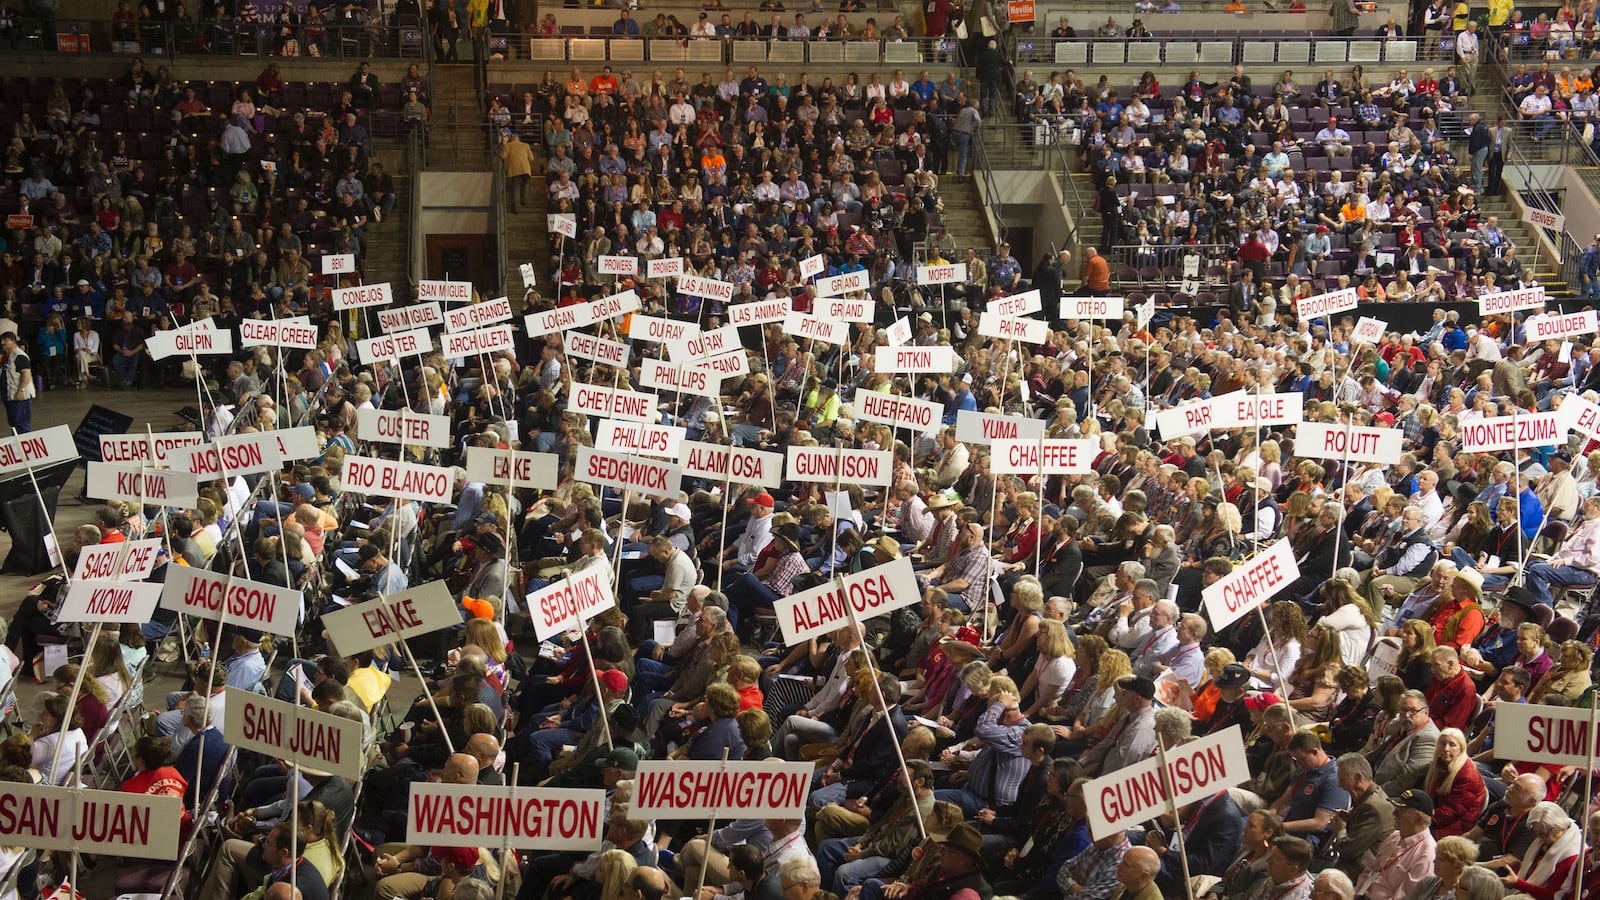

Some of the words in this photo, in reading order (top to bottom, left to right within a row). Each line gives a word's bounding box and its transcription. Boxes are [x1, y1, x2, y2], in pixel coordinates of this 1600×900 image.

[1010, 5, 1033, 15] Neville
[1531, 211, 1555, 226] DENVER
[331, 257, 345, 270] BENT
[604, 258, 633, 272] PROWERS
[653, 261, 679, 274] PROWERS
[928, 268, 955, 280] MOFFAT
[420, 284, 438, 297] SAN
[438, 284, 468, 298] MIGUEL
[679, 278, 696, 293] LAS
[697, 278, 731, 300] ANIMAS
[831, 275, 860, 292] GRAND
[341, 287, 384, 306] CONEJOS
[998, 297, 1027, 316] OTERO
[1076, 301, 1107, 315] OTERO
[1300, 292, 1355, 318] BROOMFIELD
[1485, 290, 1545, 311] BROOMFIELD
[380, 313, 399, 329] SAN
[401, 306, 438, 324] MIGUEL
[450, 312, 468, 329] RIO
[469, 301, 510, 323] GRANDE
[541, 309, 576, 330] LOGAN
[591, 297, 622, 320] OGAN
[732, 308, 752, 324] LAS
[754, 302, 788, 320] ANIMAS
[830, 303, 864, 318] GRAND
[243, 323, 277, 342] CLEAR
[281, 327, 316, 345] CREEK
[650, 321, 685, 340] OURAY
[800, 318, 833, 338] PITKIN
[999, 320, 1029, 338] PARK
[1537, 315, 1586, 337] BOULDER
[175, 334, 212, 351] GILPIN
[371, 335, 418, 358] CUSTER
[450, 330, 511, 353] ARCHULETA
[571, 336, 624, 362] CHEYENNE
[688, 333, 724, 356] OURAY
[896, 351, 932, 368] PITKIN
[654, 365, 707, 391] PHILLIPS
[577, 389, 649, 417] CHEYENNE
[864, 396, 932, 426] HUERFANO
[1238, 400, 1284, 421] EAGLE
[1186, 404, 1212, 428] PAR
[378, 415, 430, 441] CUSTER
[612, 426, 669, 451] PHILLIPS
[982, 418, 1018, 439] YUMA
[1463, 418, 1558, 447] MONTEZUMA
[0, 436, 49, 466] GILPIN
[102, 440, 150, 463] CLEAR
[1324, 430, 1381, 455] ROUTT
[189, 442, 263, 475] JACKSON
[687, 448, 763, 480] ALAMOSA
[796, 452, 878, 479] GUNNISON
[1009, 445, 1078, 468] CHAFFEE
[348, 462, 376, 489] RIO
[381, 466, 448, 498] BLANCO
[493, 456, 532, 481] LAKE
[588, 454, 669, 491] SEDGWICK
[117, 472, 167, 499] KIOWA
[82, 546, 153, 580] SAGUCHE
[1223, 554, 1284, 614] CHAFFEE
[86, 588, 134, 615] KIOWA
[184, 576, 278, 623] JACKSON
[794, 573, 895, 634] ALAMOSA
[362, 598, 423, 639] LAKE
[242, 702, 282, 748] SAN
[288, 717, 341, 765] JUAN
[1527, 715, 1600, 758] SUM
[144, 778, 182, 796] ONALD
[638, 770, 808, 809] WASHINGTON
[1100, 743, 1227, 824] GUNNISON
[0, 792, 60, 838] SAN
[72, 801, 150, 846] JUAN
[413, 794, 600, 839] WASHINGTON
